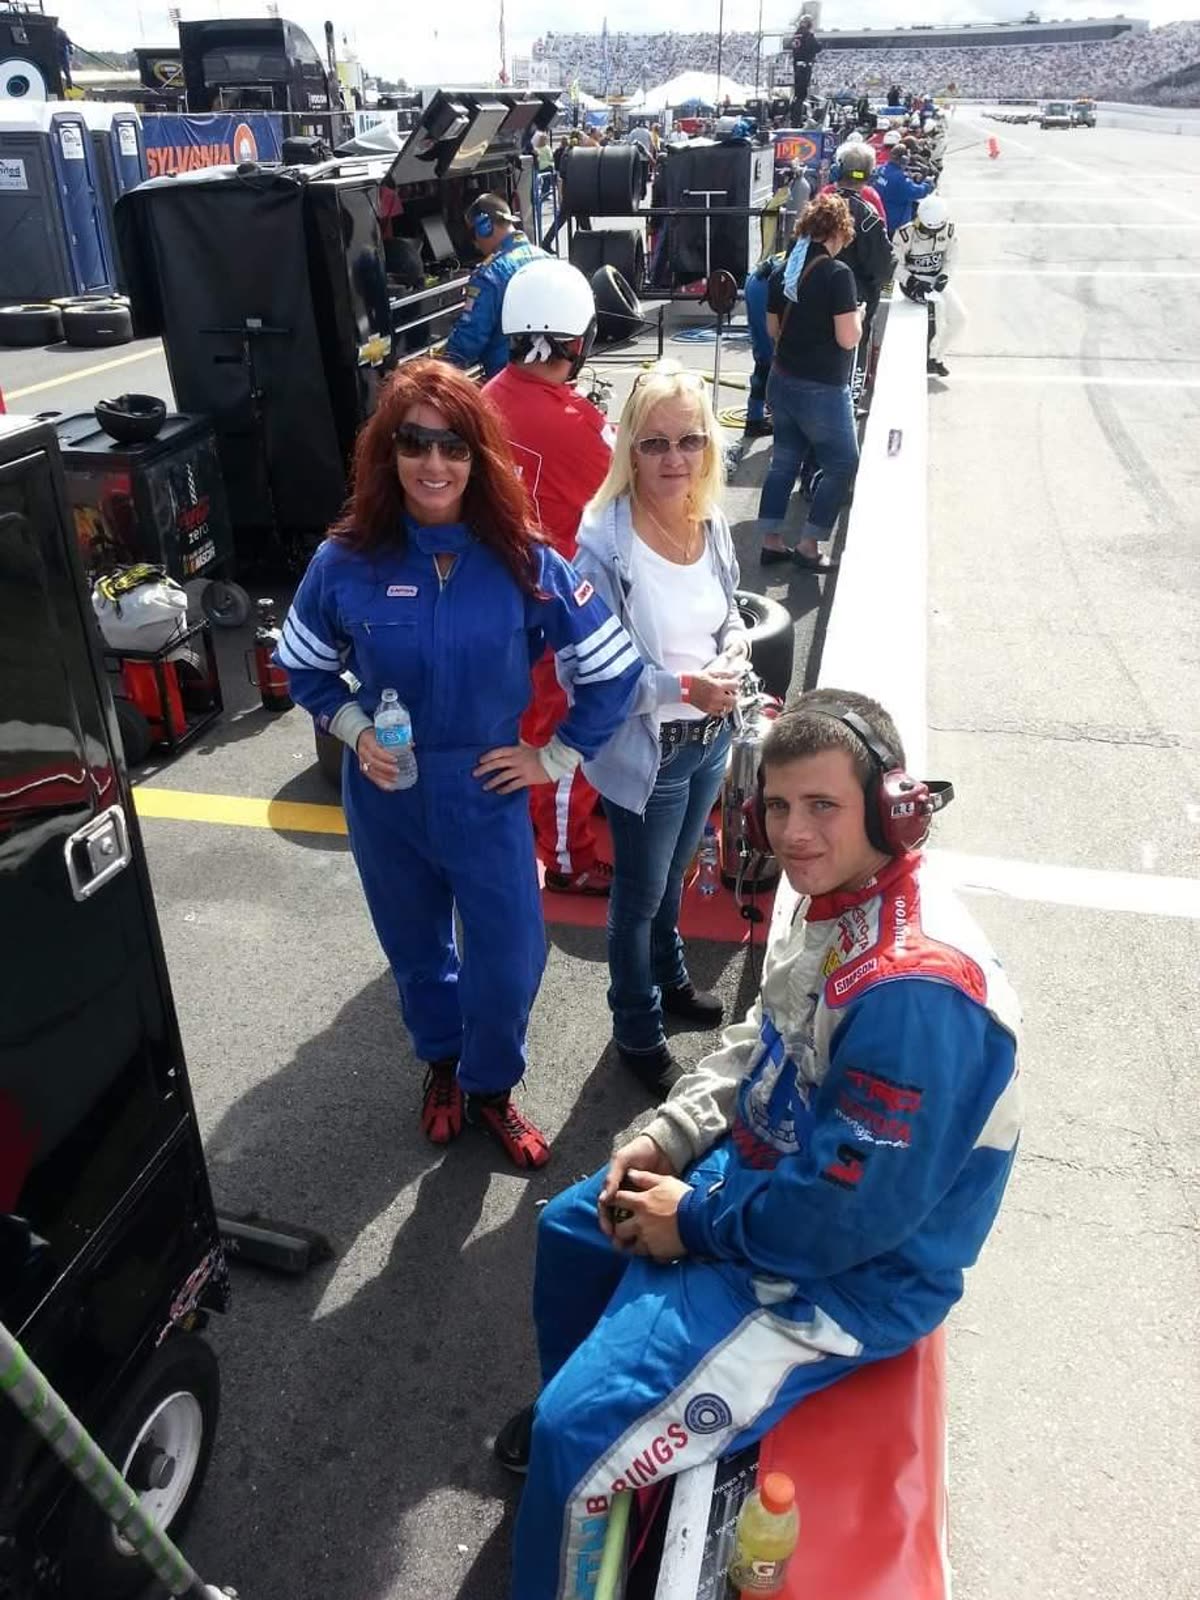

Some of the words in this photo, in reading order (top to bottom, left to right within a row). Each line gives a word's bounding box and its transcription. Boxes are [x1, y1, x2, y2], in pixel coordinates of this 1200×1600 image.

[145, 144, 231, 177] SYLVANIA
[836, 960, 876, 994] SIMPSON
[752, 1560, 776, 1577] G
